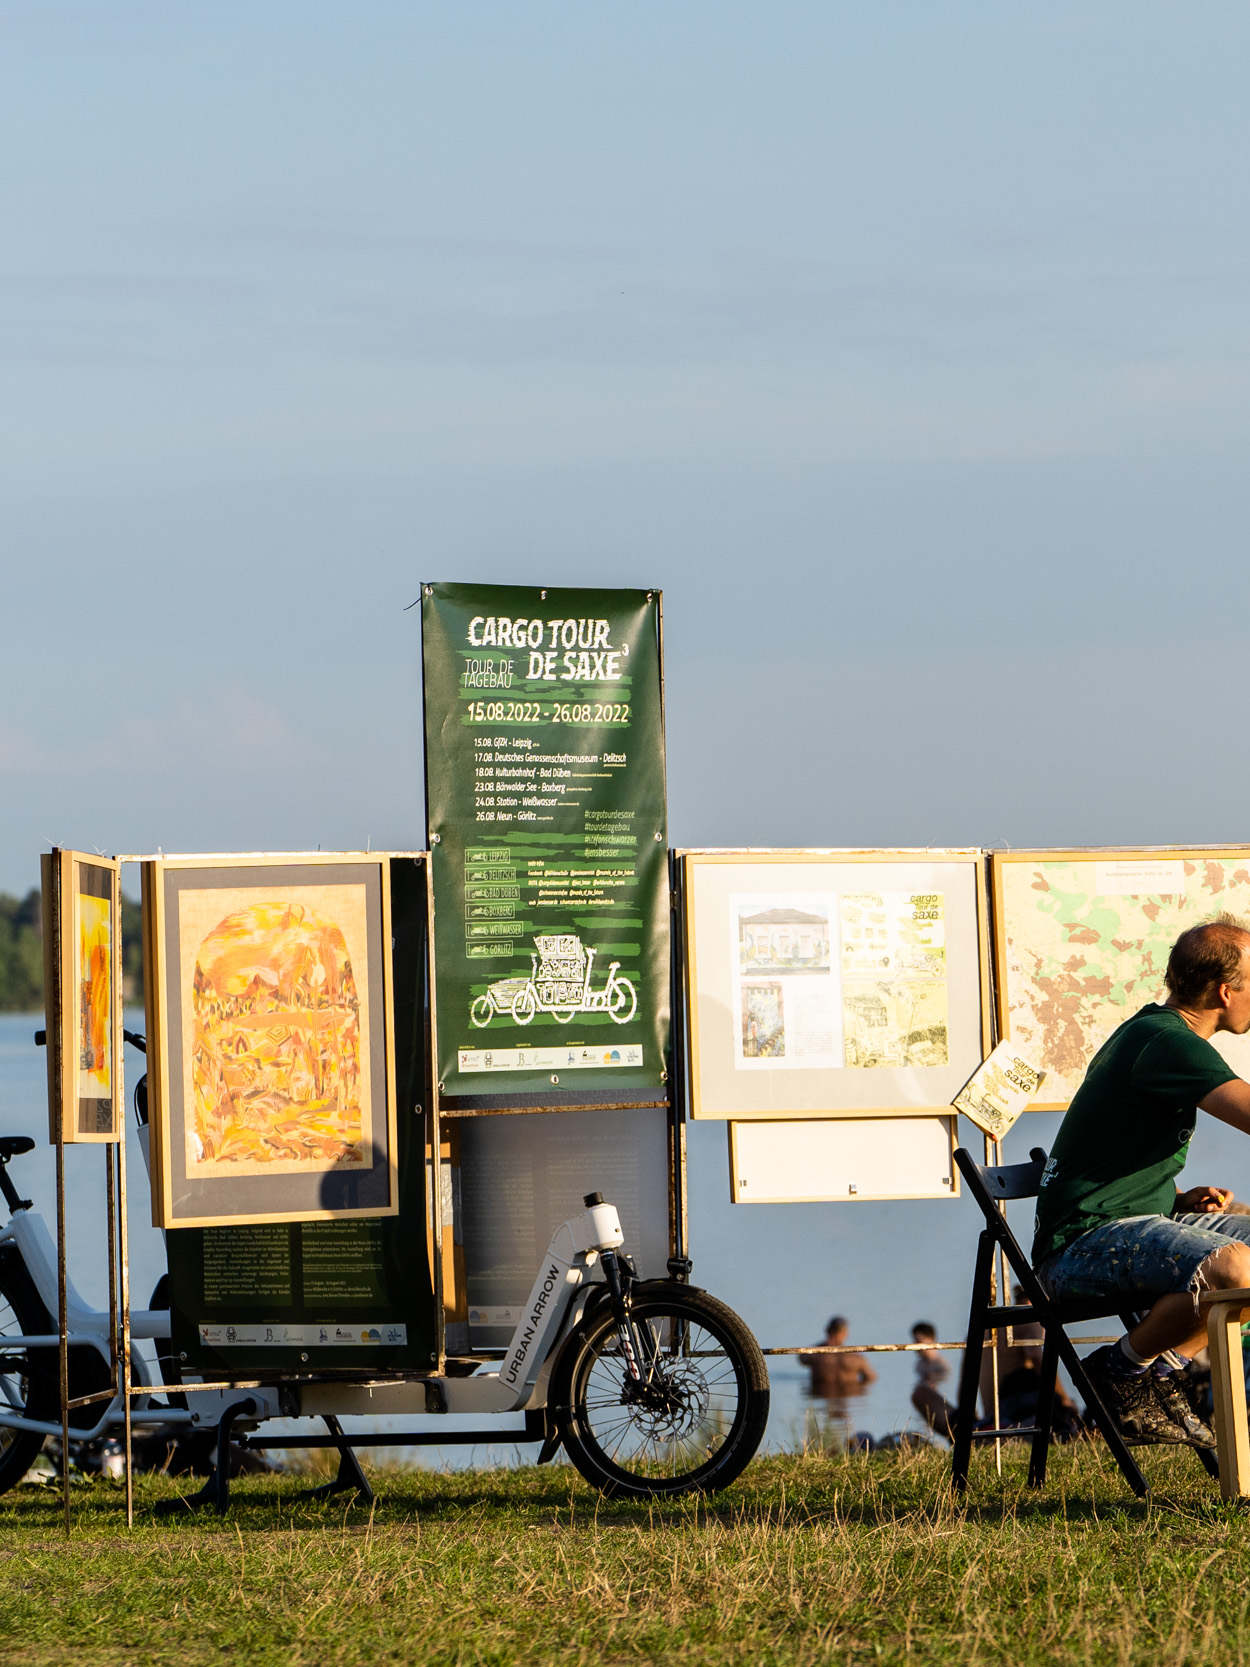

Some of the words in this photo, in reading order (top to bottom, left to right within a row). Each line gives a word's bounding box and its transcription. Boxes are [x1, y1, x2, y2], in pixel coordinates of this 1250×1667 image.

[466, 616, 544, 648] CARGO
[546, 618, 613, 649] TOUR
[465, 659, 494, 675] TOUR
[499, 660, 514, 675] DE
[526, 651, 558, 680] DE
[463, 673, 513, 688] TAGEBAU
[467, 702, 540, 721] 15.08.2022
[552, 704, 629, 723] 26.08.2022
[474, 738, 492, 747] 15.08.
[512, 738, 532, 750] Leipzig
[474, 753, 494, 762] 17.08.
[495, 752, 524, 763] Deutsches
[525, 753, 598, 765] Genossenschaftsmuseum
[603, 753, 627, 763] Delitzsch
[475, 768, 494, 777] 18.08.
[495, 767, 536, 779] Kulturbahnhof
[540, 768, 551, 777] Bad
[553, 767, 571, 778] Düben
[475, 782, 495, 792] 23.08.
[495, 782, 526, 792] Bärwalder
[527, 783, 537, 792] See
[541, 782, 566, 794] Boxberg
[475, 797, 495, 806] 24.08.
[496, 797, 518, 806] Station
[522, 796, 557, 807] Weißwasser
[476, 811, 495, 821] 26.08.
[496, 811, 513, 821] Neun
[517, 810, 537, 821] Görlitz
[585, 810, 635, 821] #cargotourdesaxe
[584, 822, 631, 833] #tourdetagebau
[489, 851, 508, 861] LEIPZIG
[489, 870, 515, 880] DELITZSCH
[489, 888, 500, 898] BAD
[910, 894, 938, 905] cargo
[489, 906, 512, 917] BOXBERG
[912, 910, 939, 920] saxe
[1013, 1056, 1040, 1080] cargo
[1004, 1069, 1031, 1093] saxe
[506, 1326, 535, 1384] URBAN
[530, 1264, 560, 1328] ARROW
